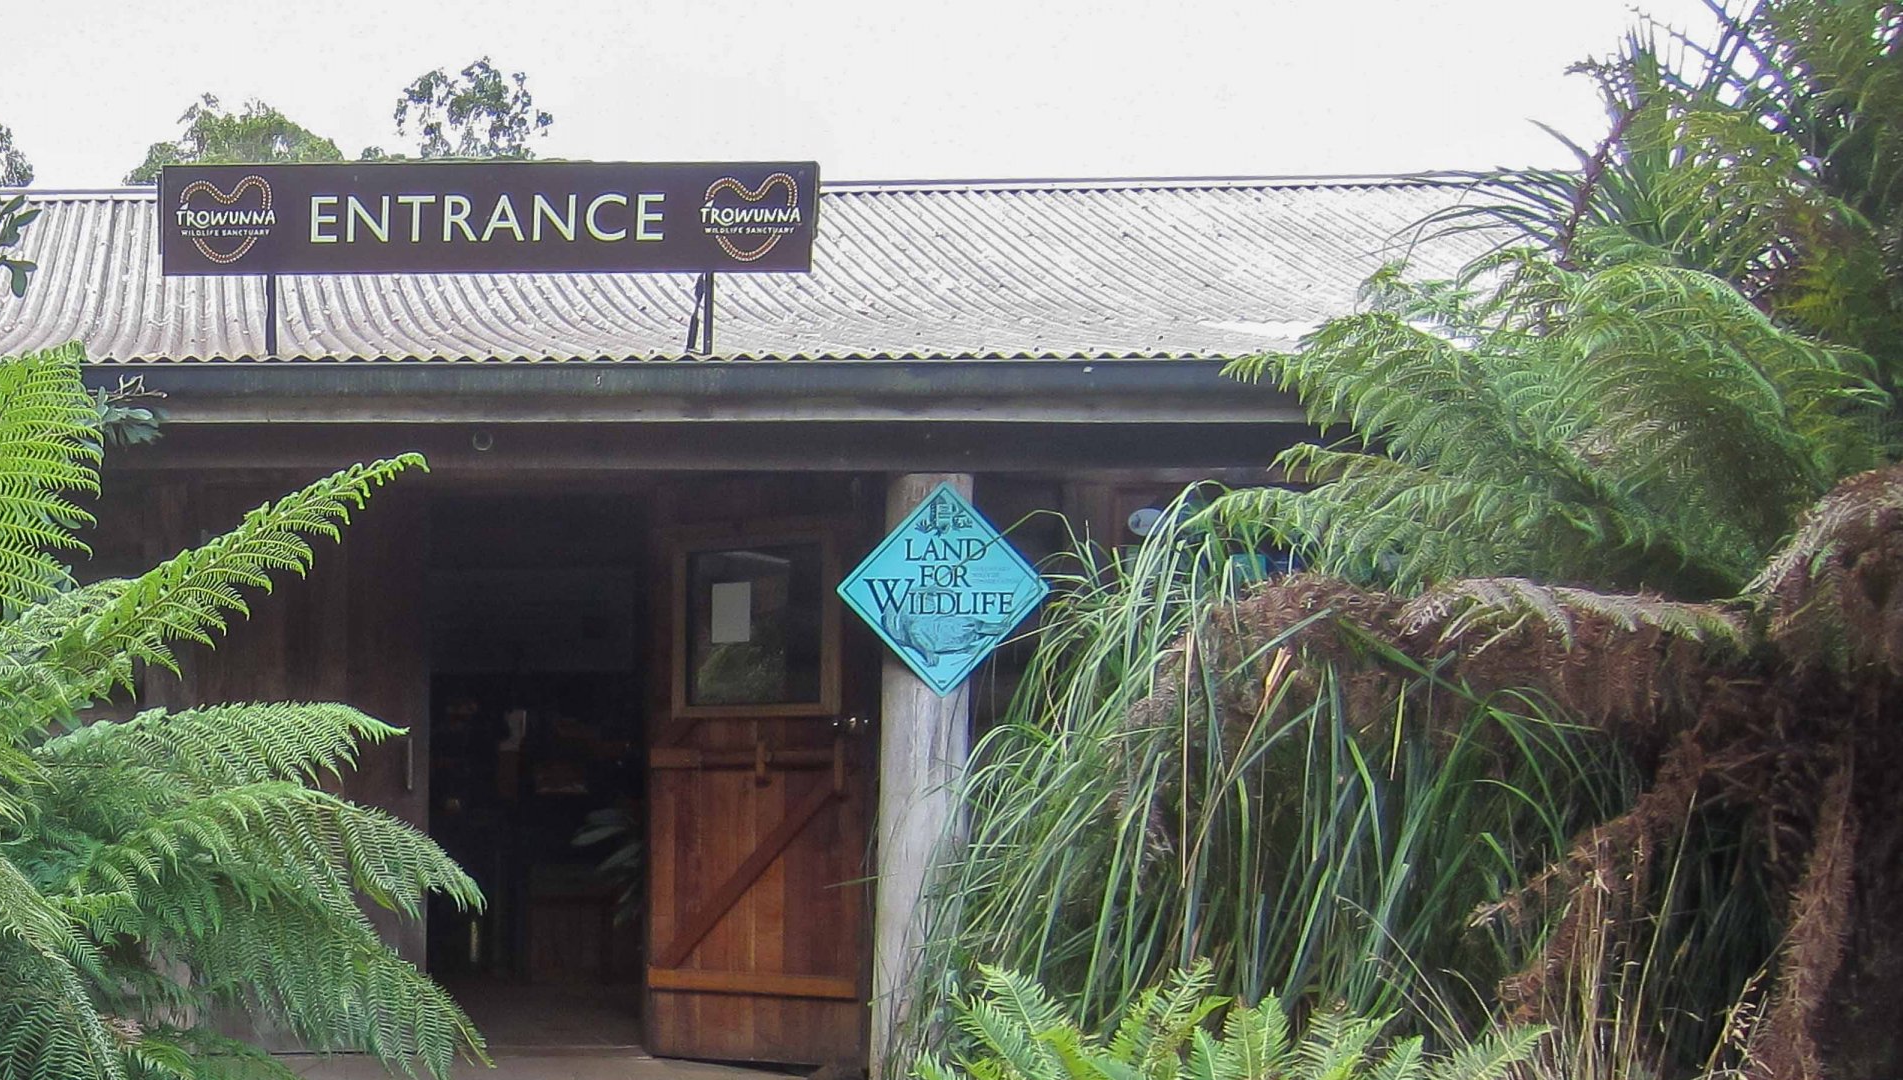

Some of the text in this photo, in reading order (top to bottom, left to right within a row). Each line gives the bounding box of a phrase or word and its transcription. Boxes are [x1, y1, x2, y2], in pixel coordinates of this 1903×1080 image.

[176, 210, 276, 228] TROWUNNA
[310, 193, 666, 243] ENTRANCE
[700, 207, 801, 226] TROWUNNA
[222, 228, 270, 236] SANCTUARY
[745, 226, 795, 234] SANCTUARY
[904, 538, 988, 561] LAND
[919, 564, 972, 588] FOR
[863, 578, 1014, 615] WILDLIFE
